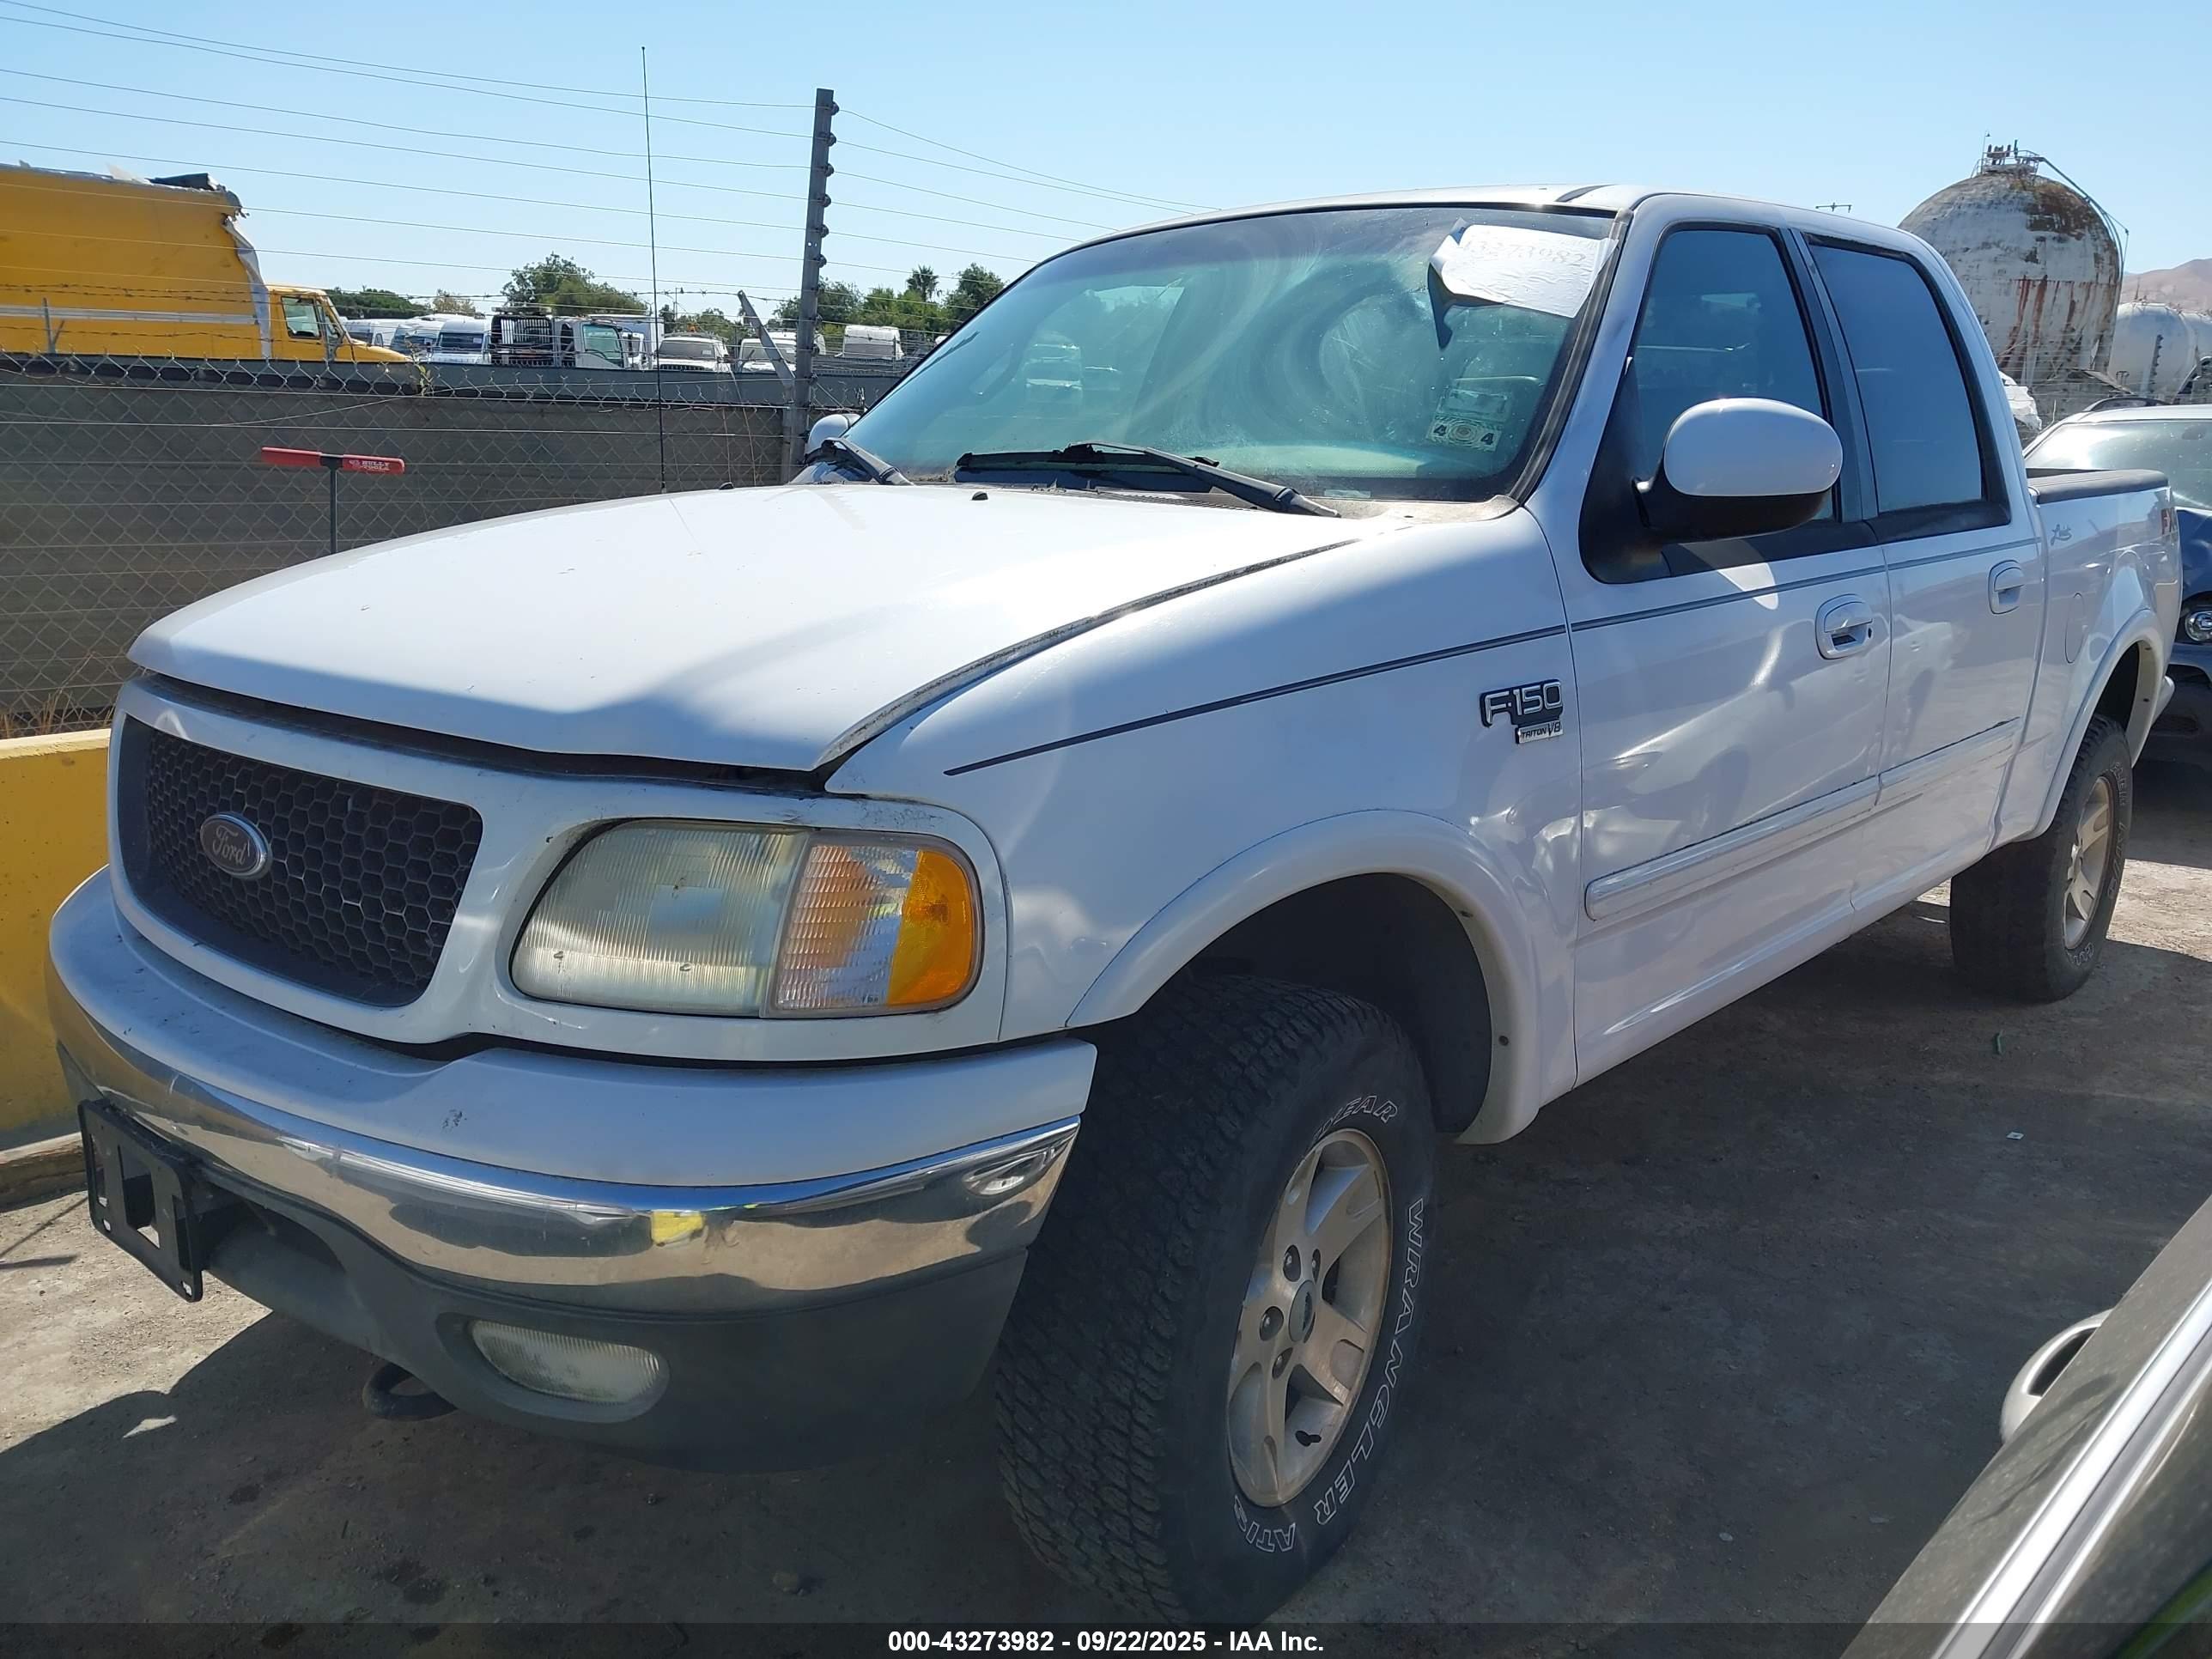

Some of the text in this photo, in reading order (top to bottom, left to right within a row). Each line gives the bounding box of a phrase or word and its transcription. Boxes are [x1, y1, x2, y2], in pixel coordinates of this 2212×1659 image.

[1520, 721, 1562, 739] TRITON V8
[212, 824, 247, 866] Ford
[1313, 1198, 1425, 1525] WRANGLER
